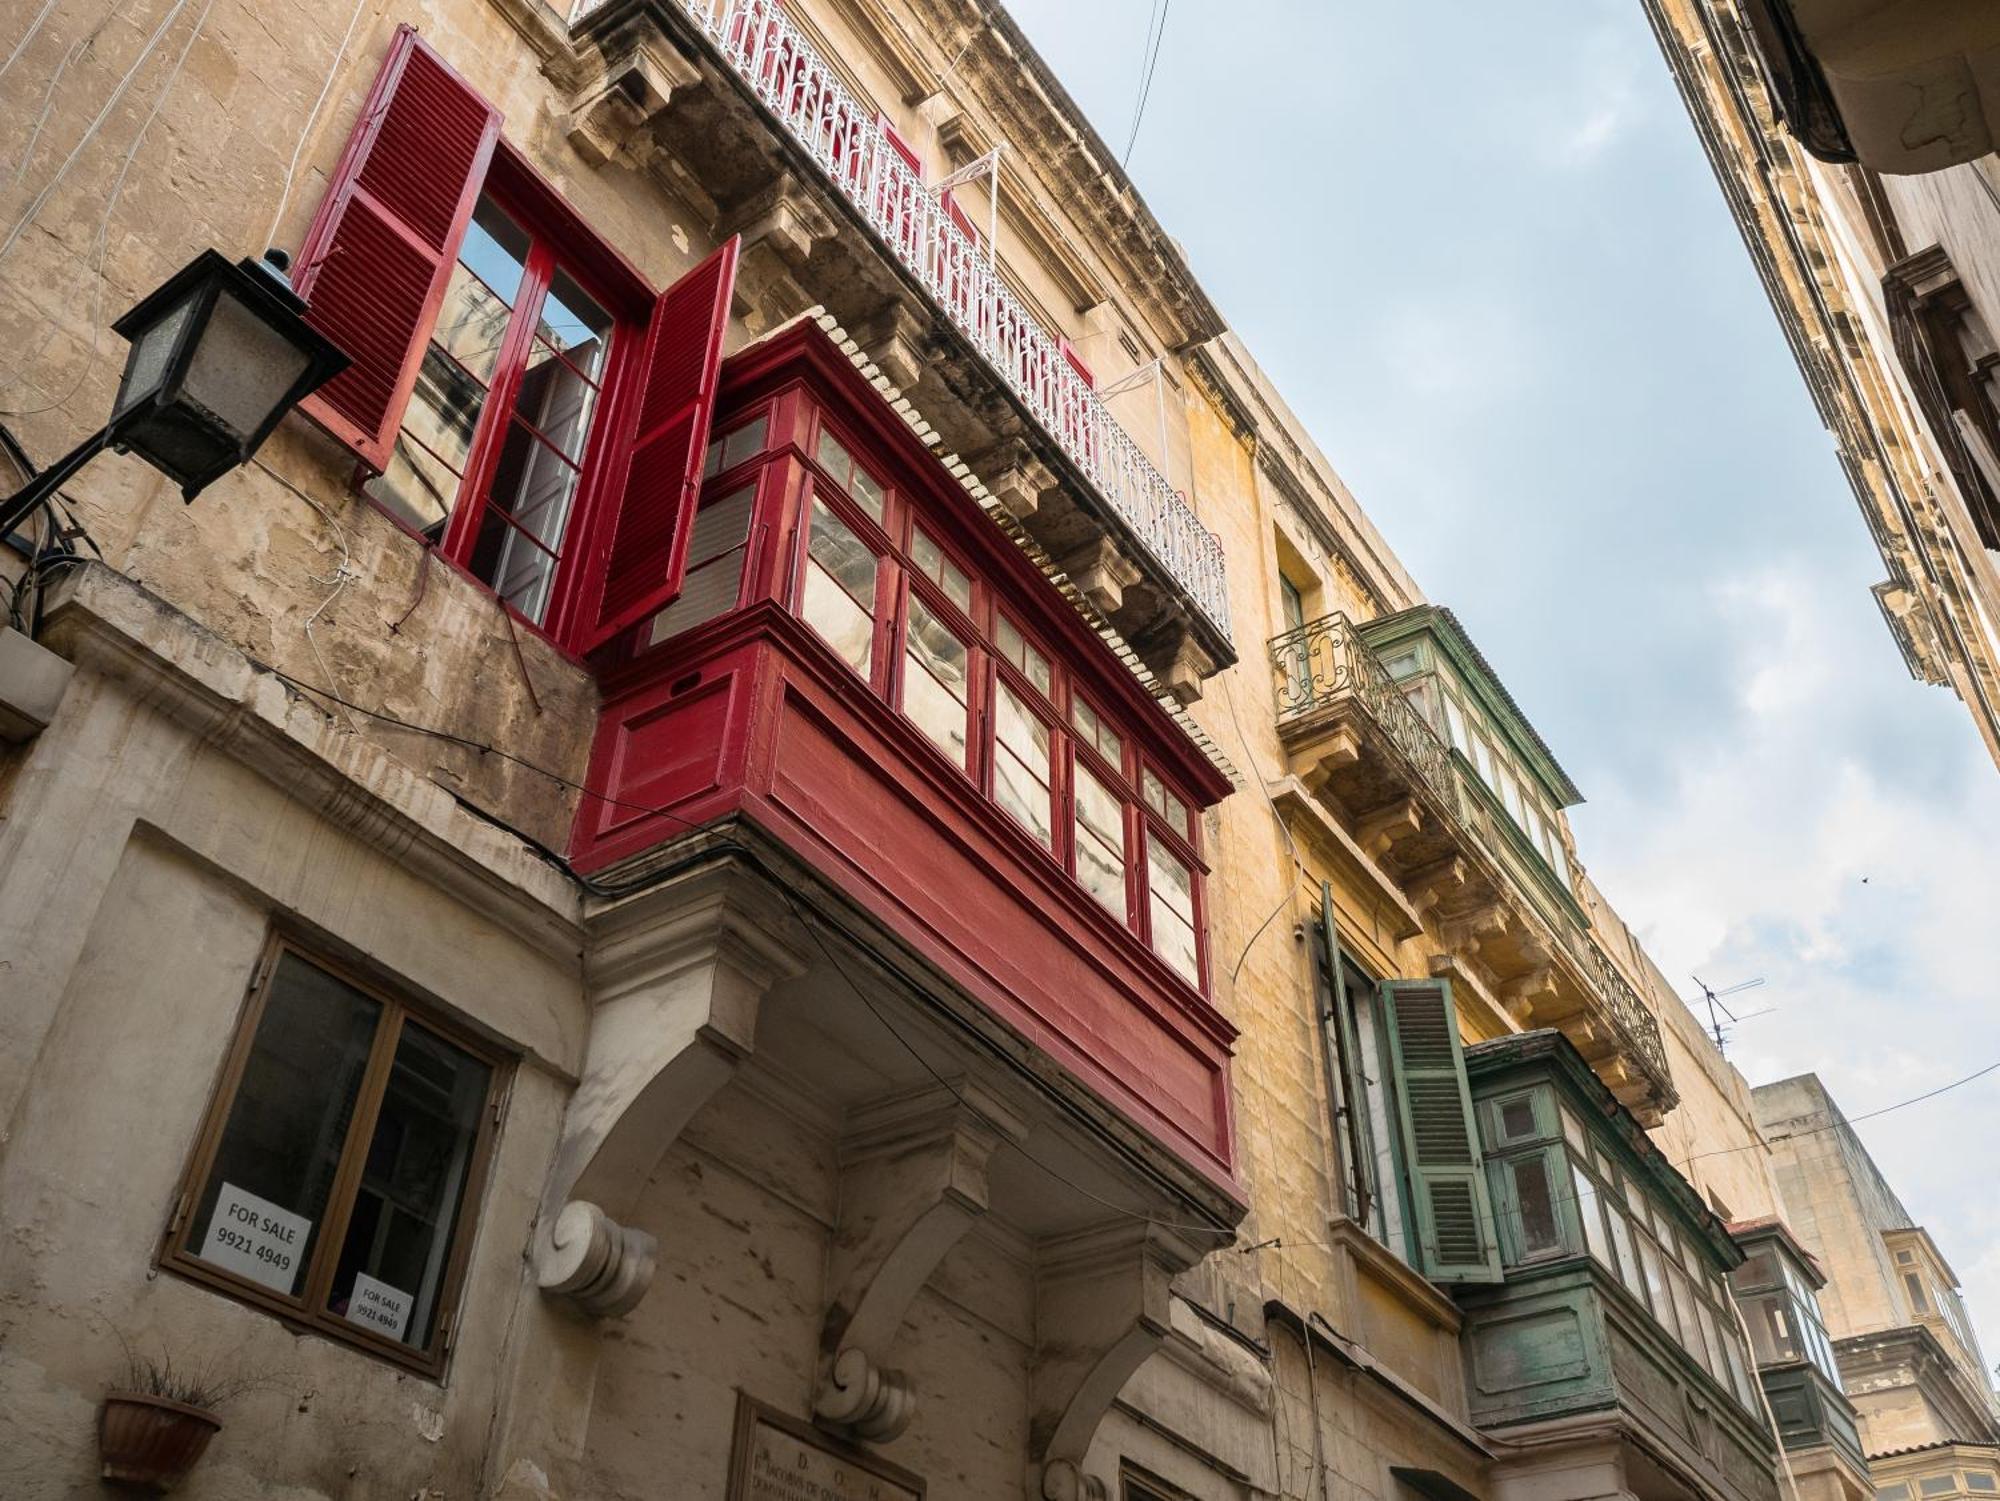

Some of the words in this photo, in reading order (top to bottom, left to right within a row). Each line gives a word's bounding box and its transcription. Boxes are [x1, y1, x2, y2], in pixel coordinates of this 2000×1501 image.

[228, 1203, 259, 1228] FOR
[261, 1218, 296, 1245] SALE
[217, 1227, 252, 1254] 9921
[256, 1246, 290, 1270] 4949
[357, 1303, 377, 1320] 9921
[377, 1314, 398, 1330] 4949
[363, 1288, 380, 1304] FOR
[381, 1297, 400, 1313] SALE
